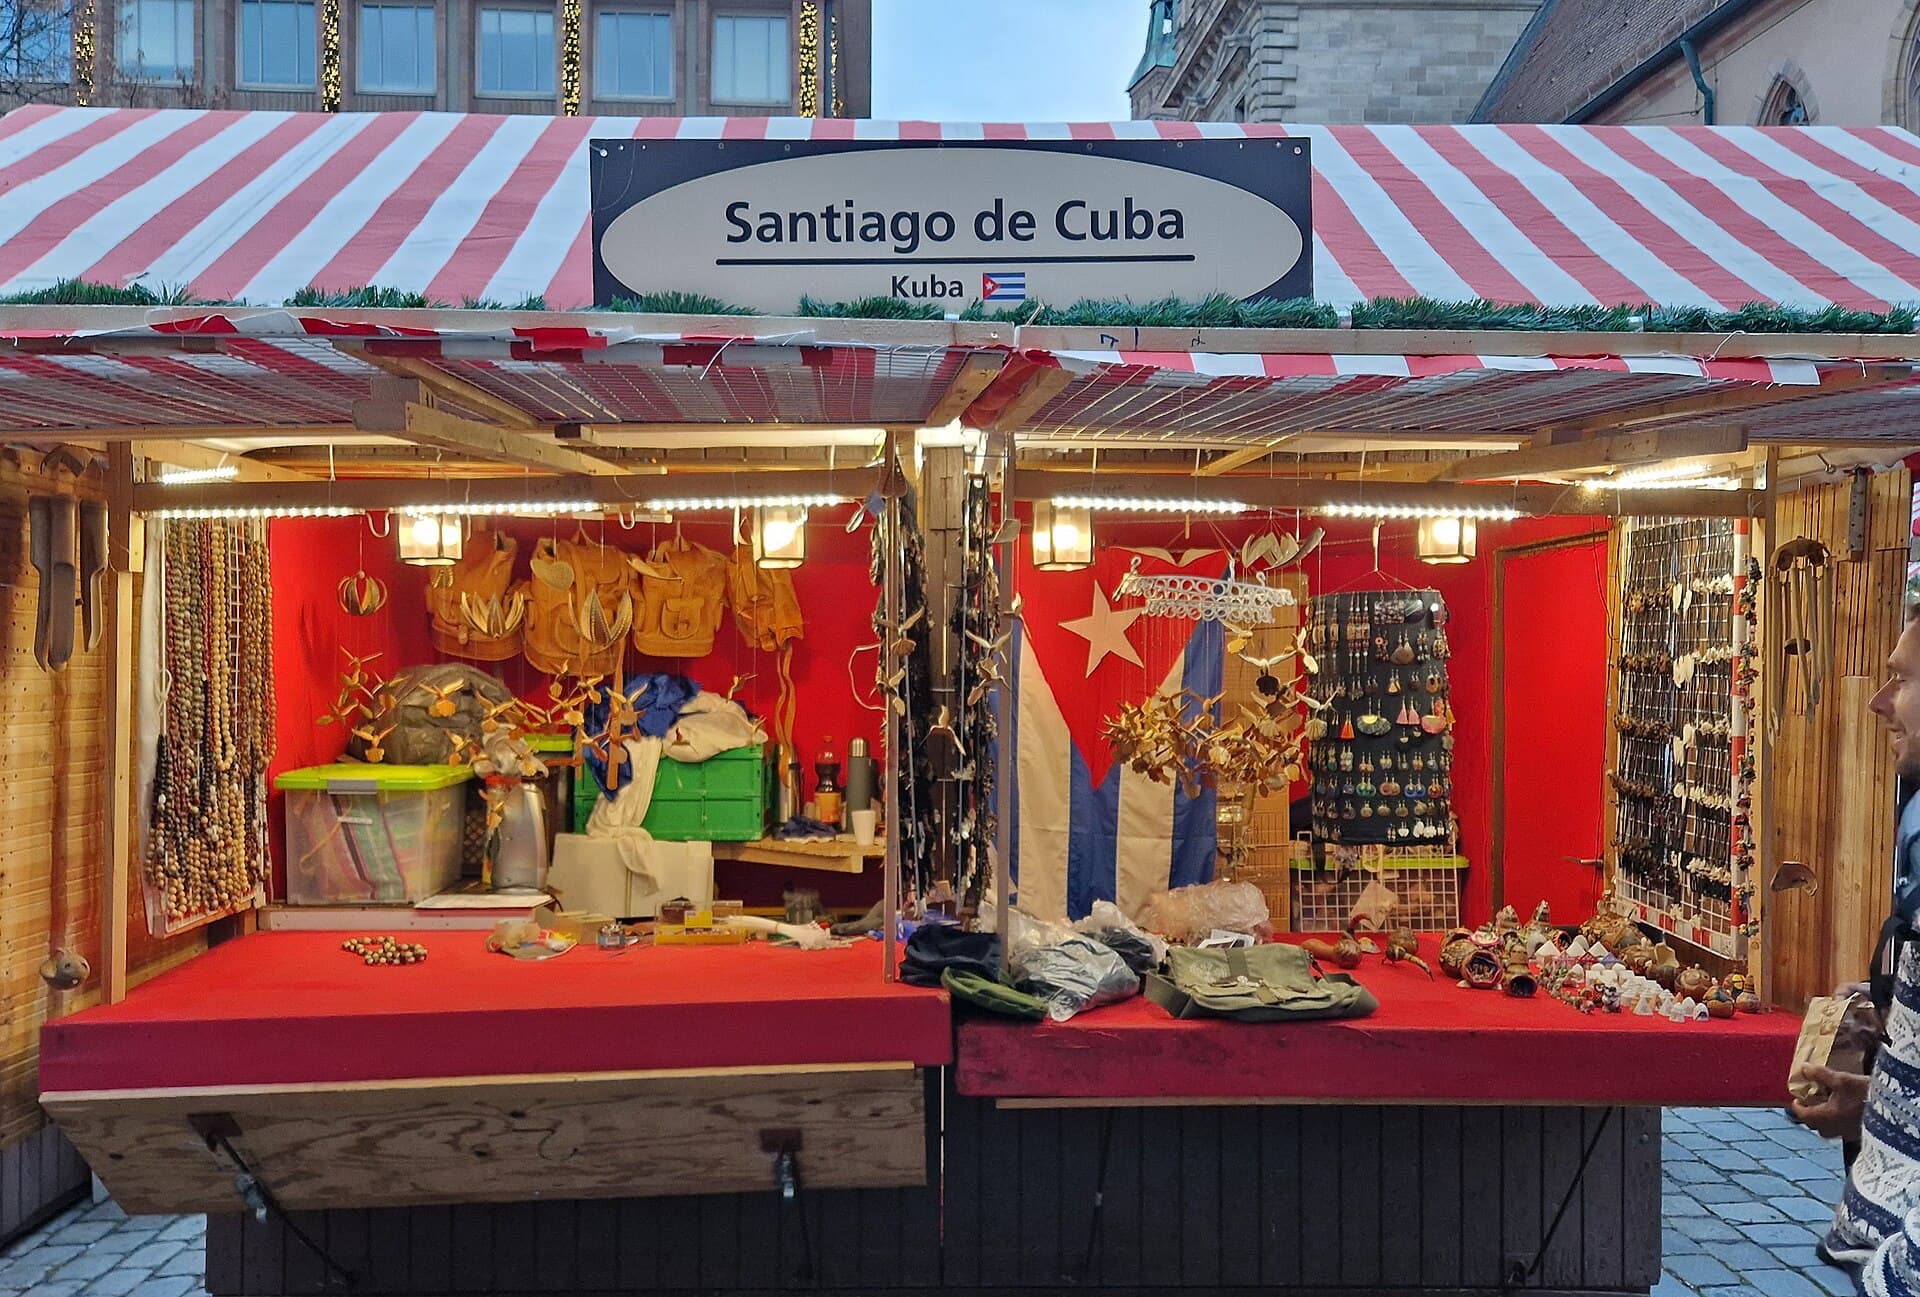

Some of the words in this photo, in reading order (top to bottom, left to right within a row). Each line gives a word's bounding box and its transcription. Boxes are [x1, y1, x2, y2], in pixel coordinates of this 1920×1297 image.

[725, 199, 956, 255] Santiago
[973, 197, 1037, 242] de
[1055, 196, 1185, 241] Cuba
[891, 274, 965, 298] Kuba
